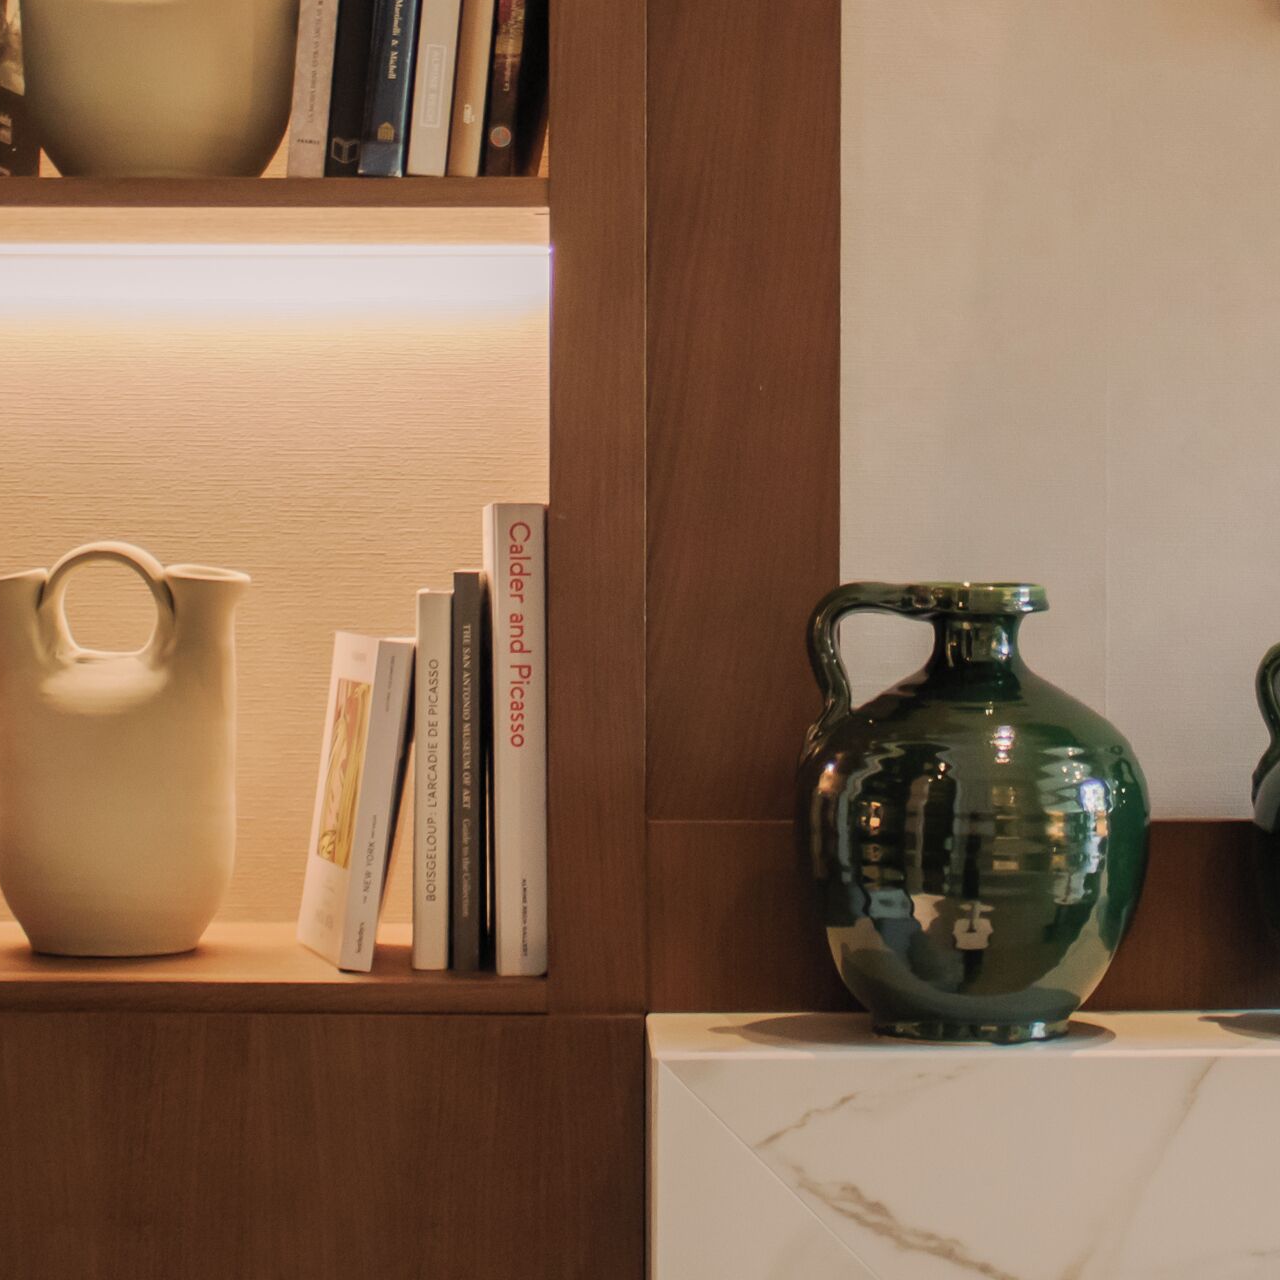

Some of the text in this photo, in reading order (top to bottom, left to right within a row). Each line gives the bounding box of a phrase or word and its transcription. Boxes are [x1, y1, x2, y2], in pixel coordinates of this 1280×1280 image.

[509, 521, 532, 747] Calder and Picasso
[427, 659, 439, 717] PICASSO
[462, 624, 472, 810] THE SAN ANTONIO MUSEUM OF ART
[427, 720, 438, 738] DE
[426, 741, 438, 809] L'ARCADIE
[362, 871, 372, 893] NEW
[365, 841, 376, 867] YORK
